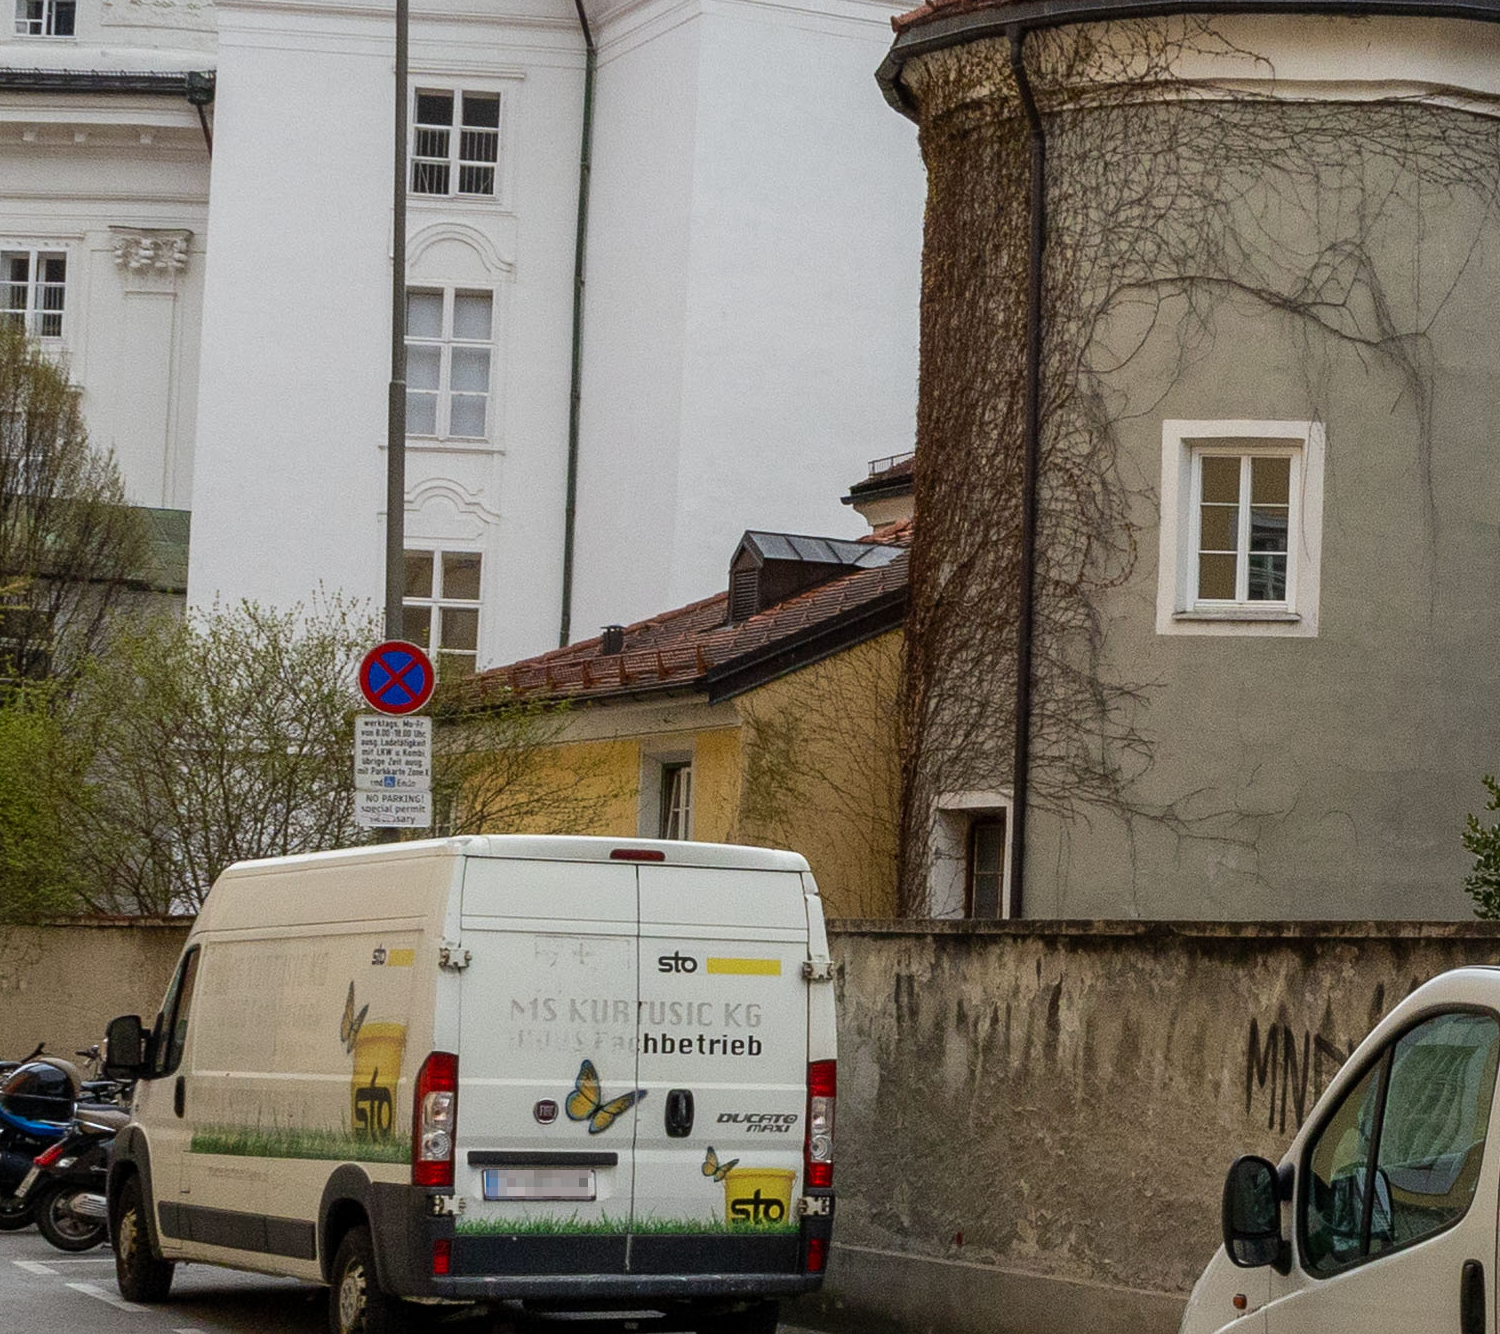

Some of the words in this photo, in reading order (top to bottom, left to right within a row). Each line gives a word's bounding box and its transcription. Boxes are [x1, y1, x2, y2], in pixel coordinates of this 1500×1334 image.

[658, 950, 698, 973] sto
[723, 1003, 763, 1028] KG
[716, 1113, 798, 1123] DUCATO
[746, 1124, 791, 1133] MAXI
[731, 1188, 784, 1225] sto
